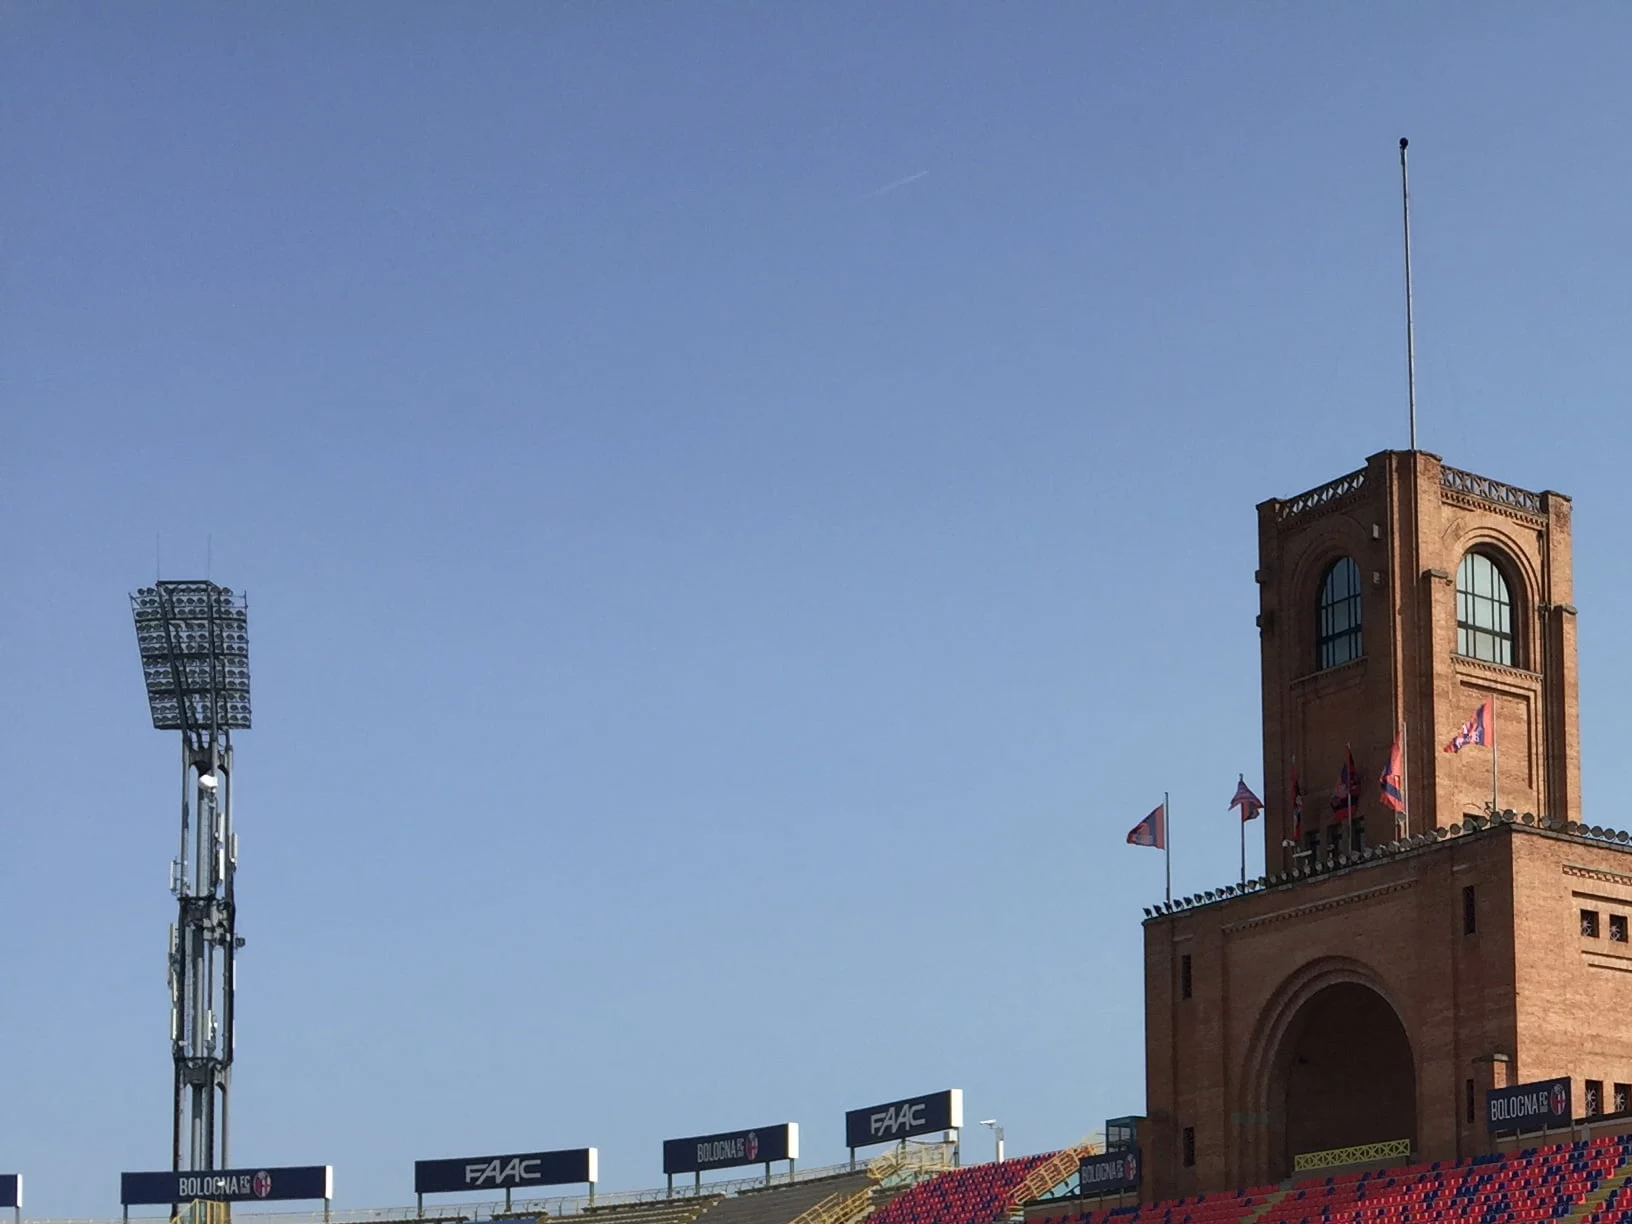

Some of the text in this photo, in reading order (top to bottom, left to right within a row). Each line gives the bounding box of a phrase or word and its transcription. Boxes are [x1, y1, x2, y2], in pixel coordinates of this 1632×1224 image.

[871, 1103, 926, 1136] FAAC
[1491, 1093, 1538, 1121] BOLOGNA
[697, 1139, 736, 1163] BOLOGNA
[465, 1158, 541, 1185] FAAC
[179, 1175, 239, 1196] BOLOGNA
